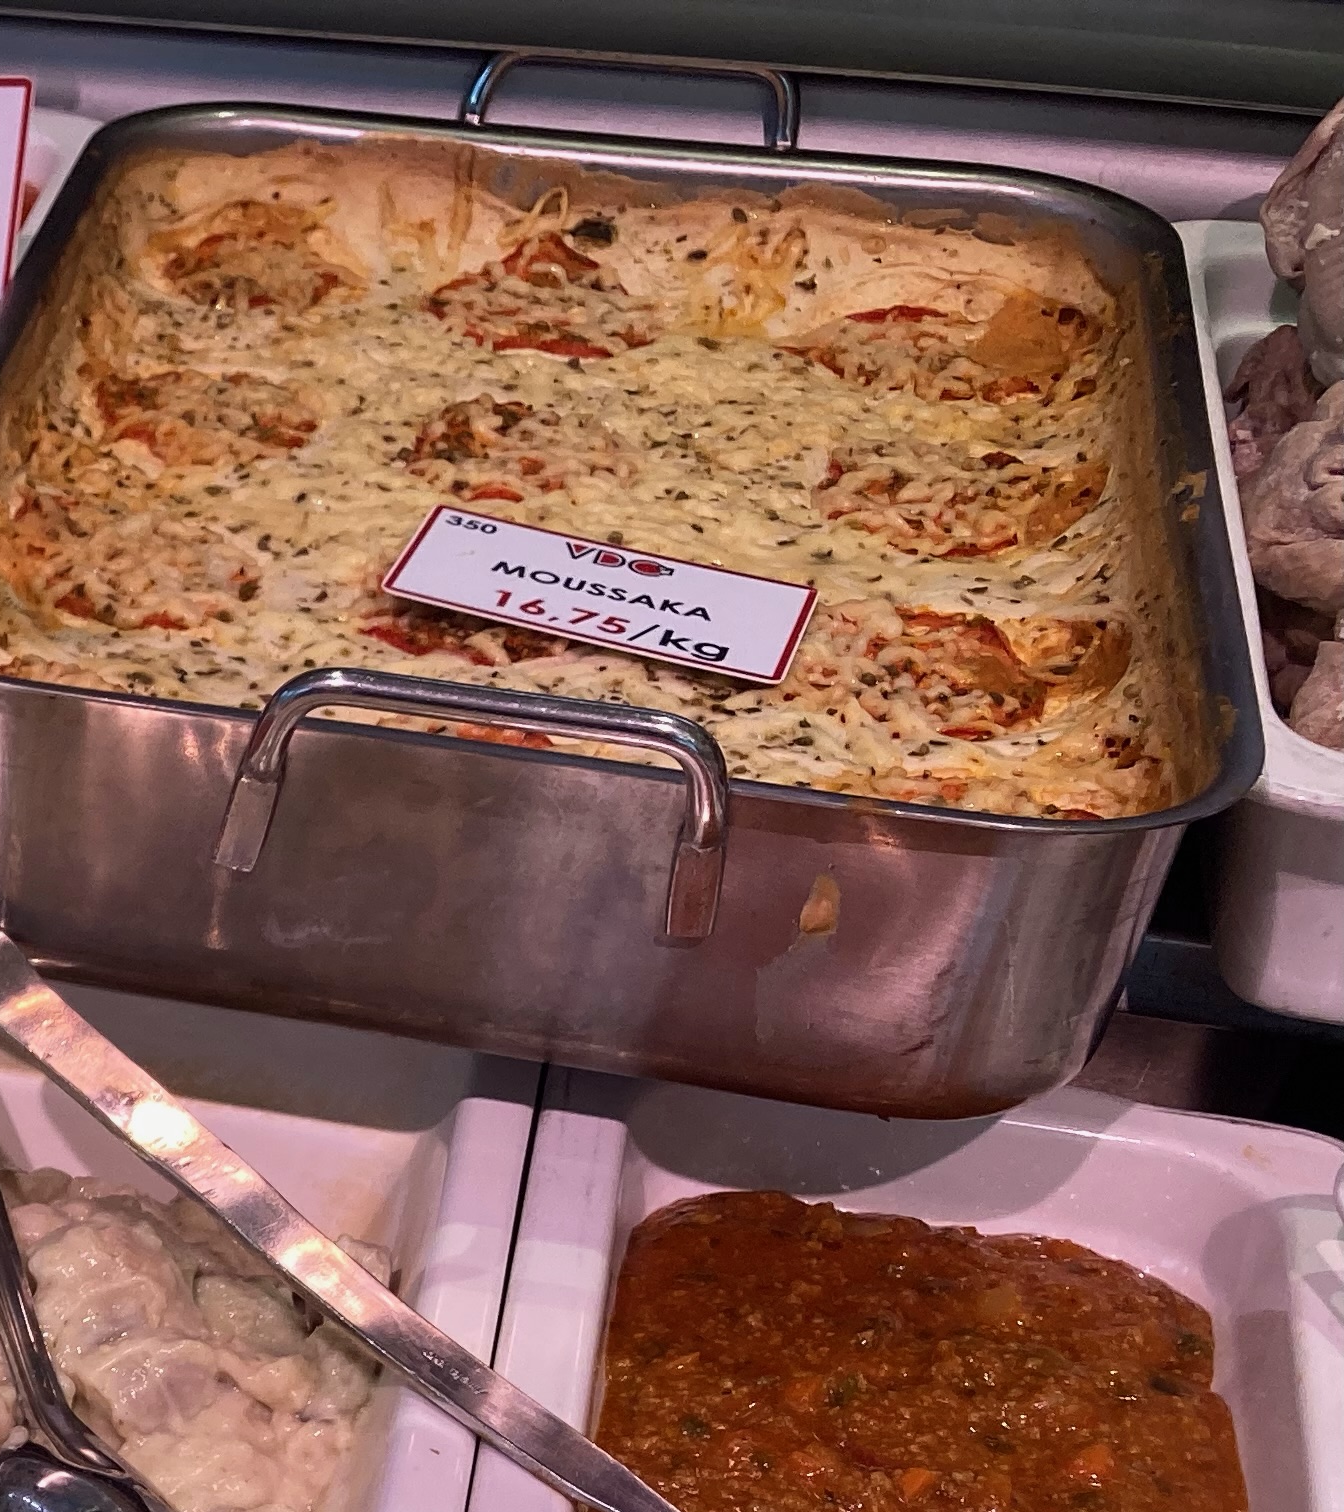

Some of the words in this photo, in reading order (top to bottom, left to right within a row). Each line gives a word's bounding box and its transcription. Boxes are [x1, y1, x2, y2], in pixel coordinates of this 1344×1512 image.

[445, 514, 498, 536] 350
[491, 560, 712, 622] MOUSSAKA
[495, 589, 730, 664] 16,75/kg
